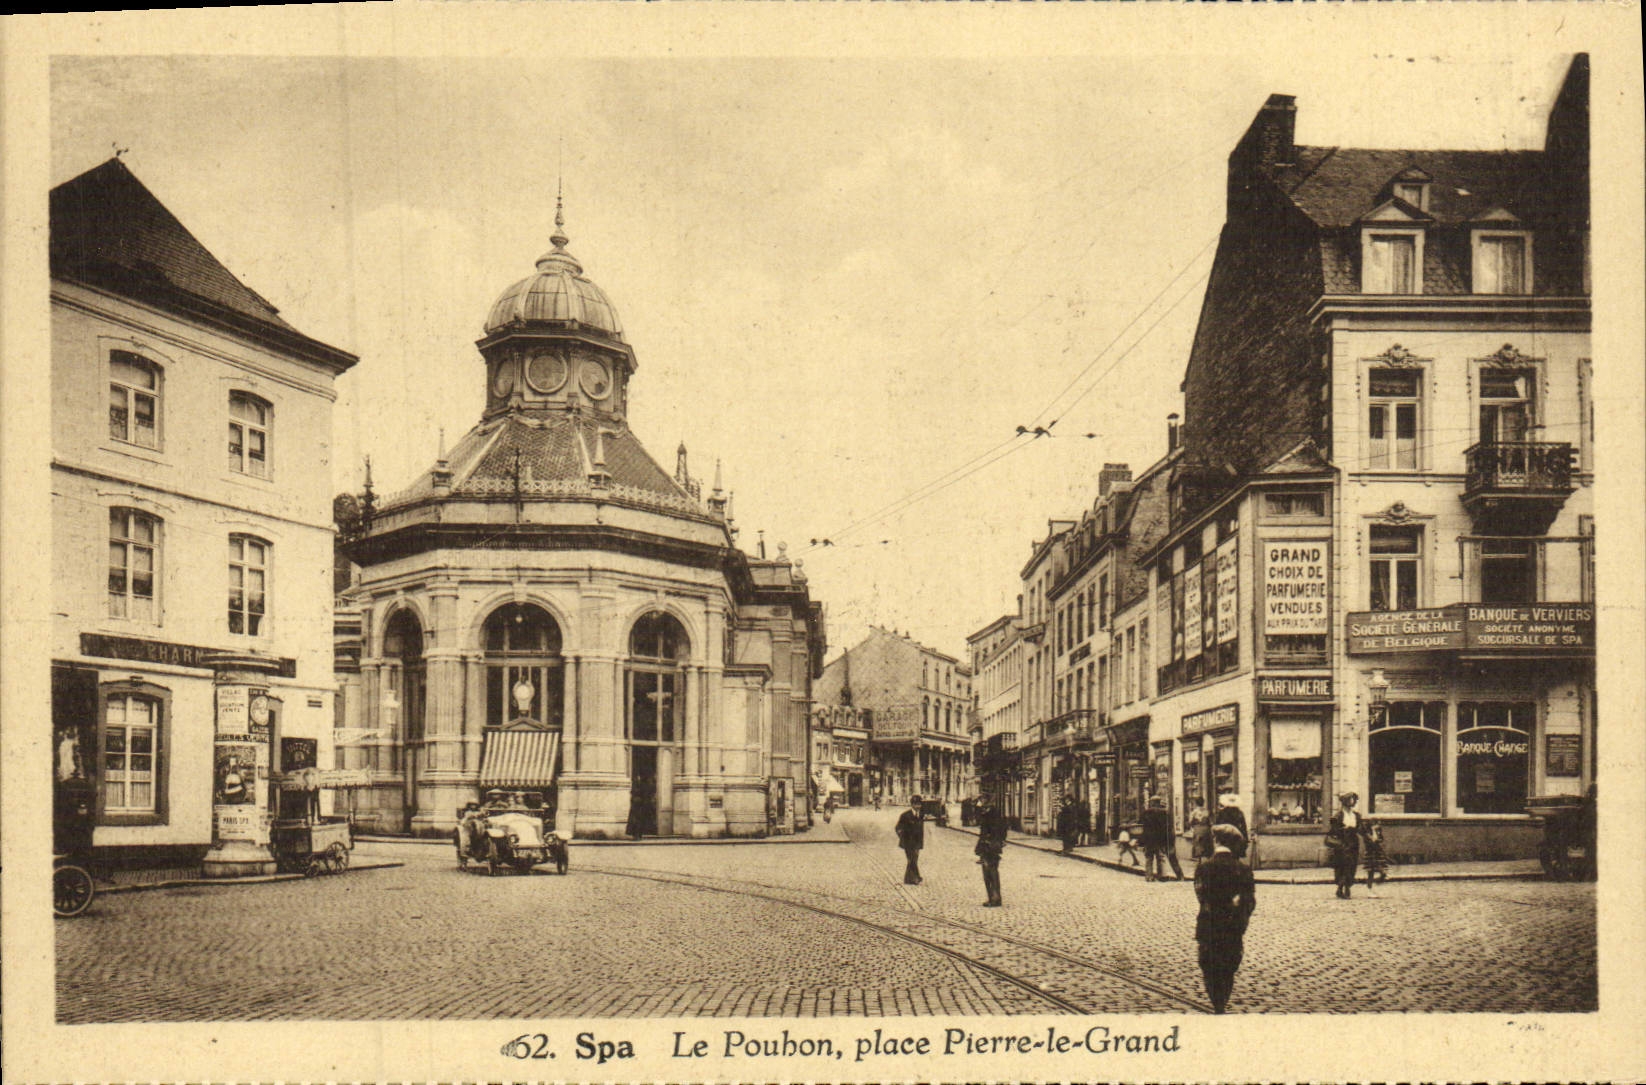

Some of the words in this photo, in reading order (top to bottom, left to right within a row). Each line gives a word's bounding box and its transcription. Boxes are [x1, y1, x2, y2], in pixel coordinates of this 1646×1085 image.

[1270, 548, 1321, 562] GRAND
[1269, 566, 1304, 579] CHOIX
[1307, 566, 1323, 579] DE
[1266, 583, 1326, 598] PARFUMERIE
[1270, 602, 1323, 615] VENDUES
[1469, 607, 1518, 622] BANQUE
[1532, 607, 1592, 621] VERVIERS
[1370, 612, 1414, 622] AGENCE
[1416, 612, 1430, 620] DE
[1431, 611, 1444, 619] LA
[1351, 623, 1398, 636] SOCIÉTÉ
[1528, 625, 1576, 633] ANONYME
[1363, 639, 1381, 648] DE
[1384, 636, 1448, 648] BELGIQUE
[1478, 635, 1540, 645] SUCCURSALE
[1544, 635, 1557, 645] DE
[1561, 635, 1583, 645] SPA
[146, 644, 205, 665] PHARM
[1262, 679, 1331, 696] PARFUMERIE
[1183, 707, 1236, 731] PARFUMERIE
[1494, 740, 1529, 757] CHANGE
